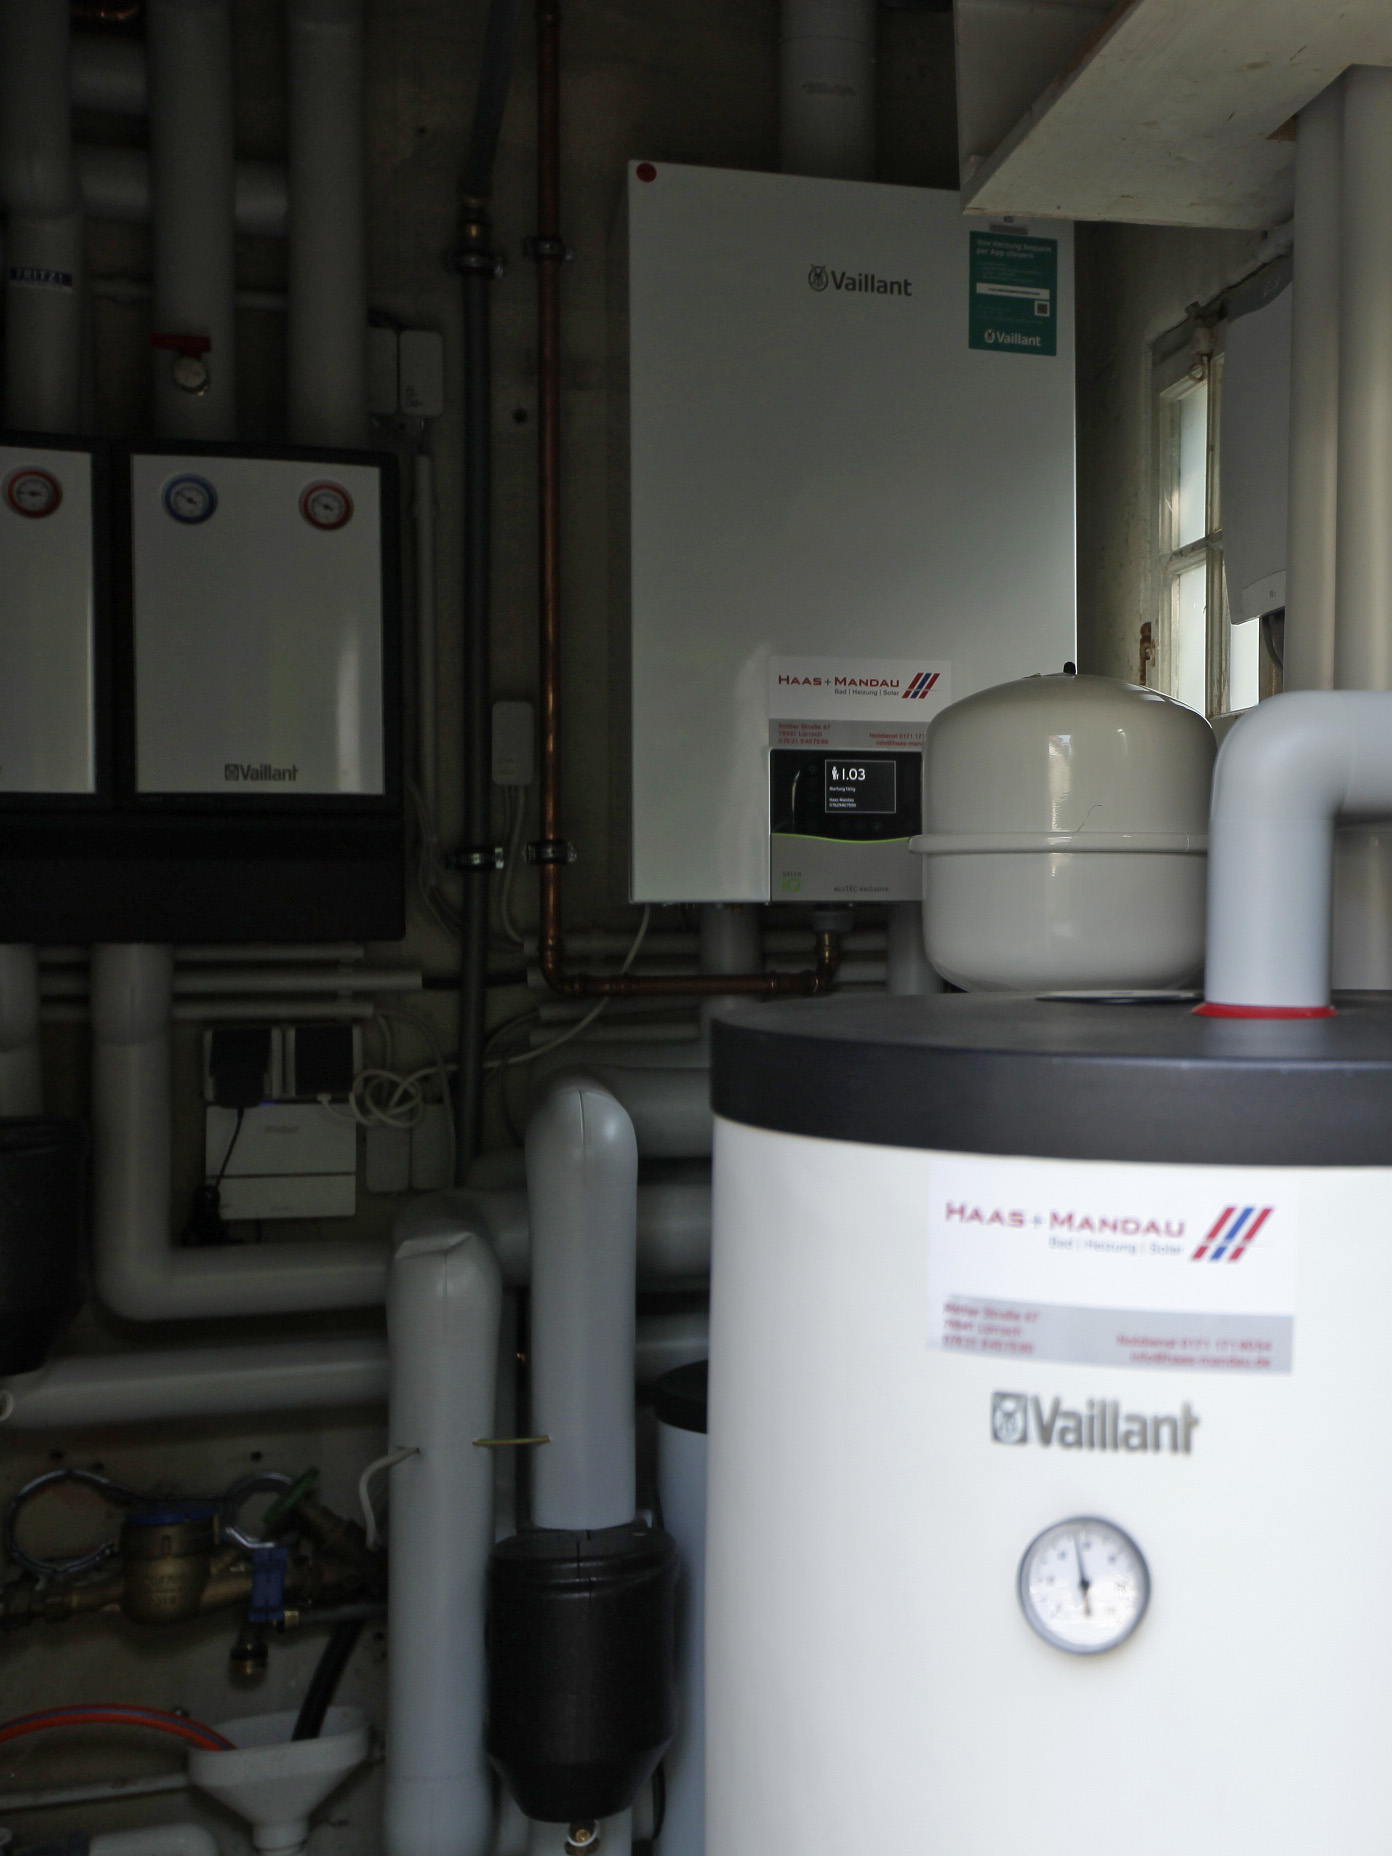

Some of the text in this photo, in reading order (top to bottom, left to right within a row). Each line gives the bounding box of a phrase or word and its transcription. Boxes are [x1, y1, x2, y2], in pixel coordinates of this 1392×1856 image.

[830, 270, 913, 296] Vaillant
[996, 331, 1042, 347] Vaillant
[778, 675, 822, 686] HAAS
[834, 676, 900, 687] MANDAU
[852, 689, 878, 697] Heizung
[239, 763, 299, 782] Vaillant
[842, 767, 866, 781] 1.03
[944, 1202, 1025, 1228] HAAS
[1048, 1211, 1186, 1238] MANDAU
[1029, 1394, 1200, 1455] Vaillant
